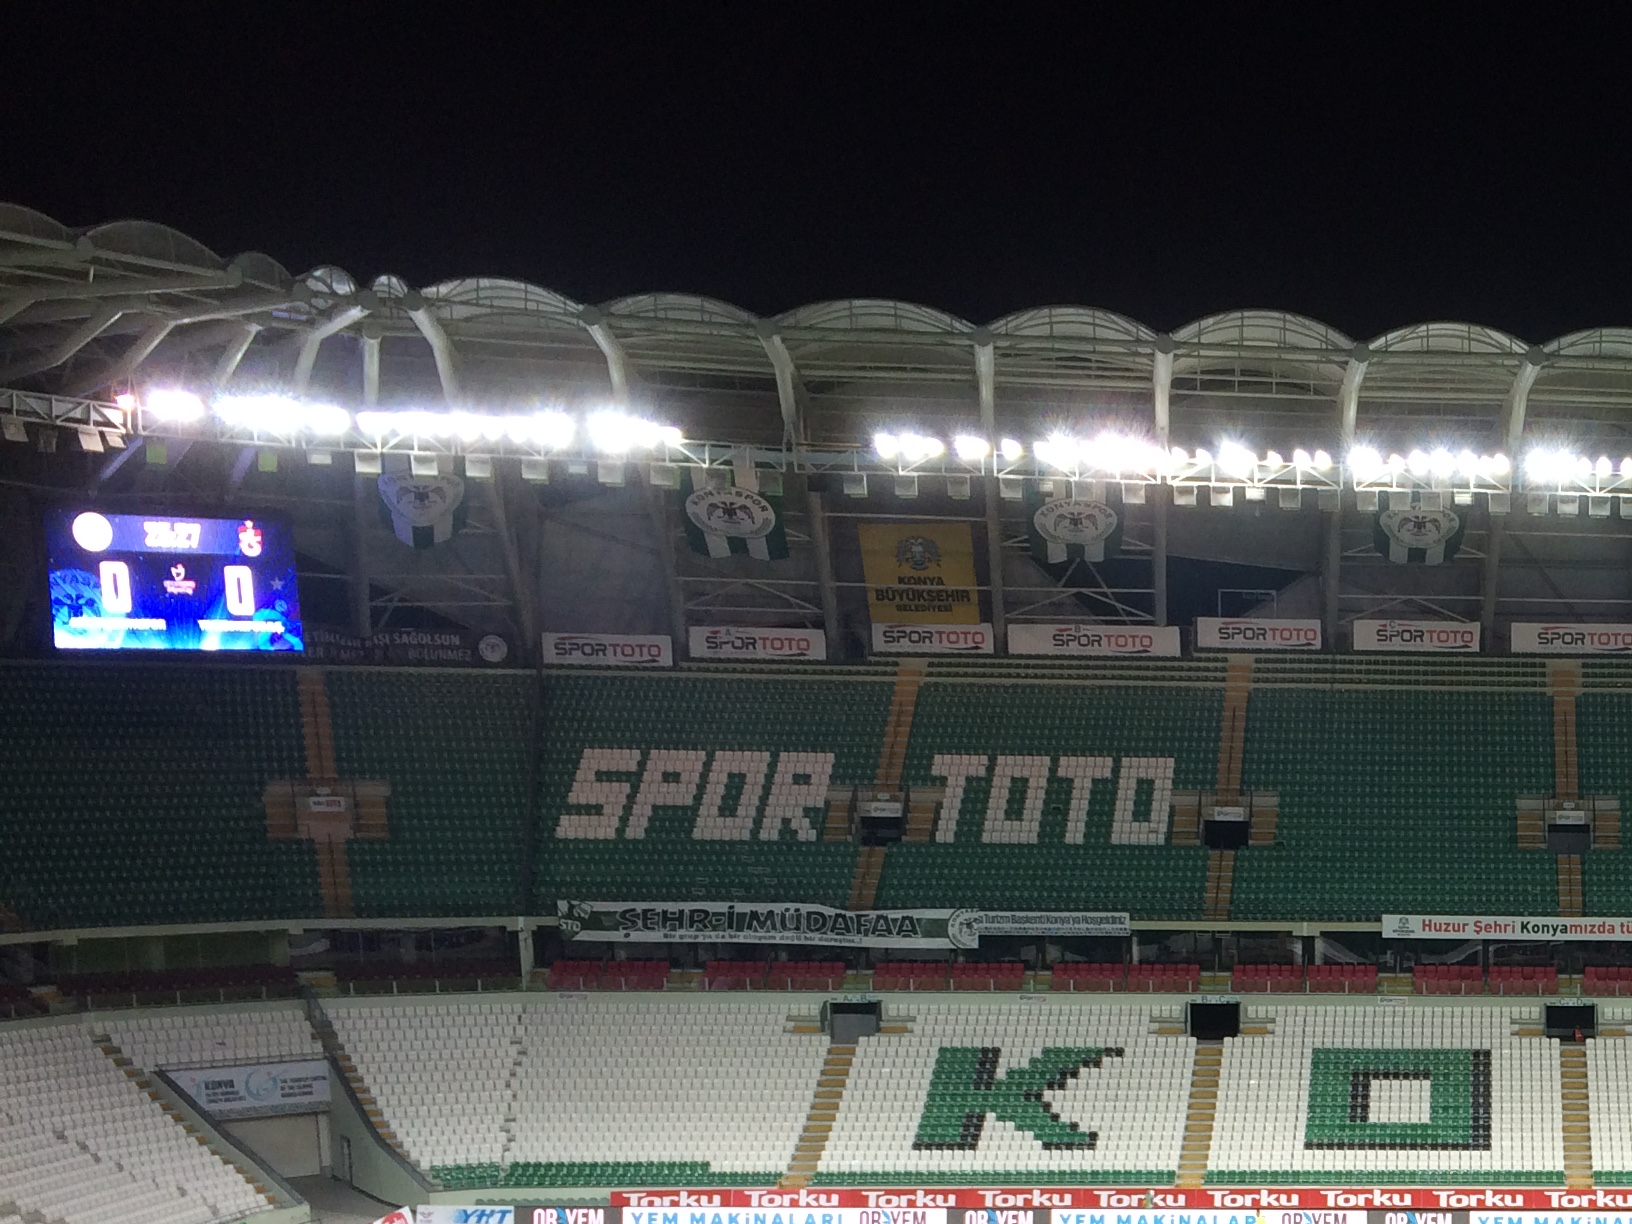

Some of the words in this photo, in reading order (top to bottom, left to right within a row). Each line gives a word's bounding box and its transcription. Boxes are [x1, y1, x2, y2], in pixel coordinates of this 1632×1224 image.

[556, 748, 836, 841] SPOR
[931, 753, 1175, 846] TOTO
[749, 907, 922, 938] MÜDAFAA
[1421, 919, 1469, 933] Huzur
[1473, 919, 1516, 936] Şehri
[1520, 920, 1616, 938] Konyamızda
[622, 1192, 721, 1207] Torku
[744, 1189, 839, 1207] Torku
[861, 1190, 956, 1207] Torku
[978, 1190, 1072, 1207] Torku
[1207, 1189, 1299, 1207] Torku
[1320, 1189, 1412, 1207] Torku
[1432, 1189, 1524, 1207] Torku
